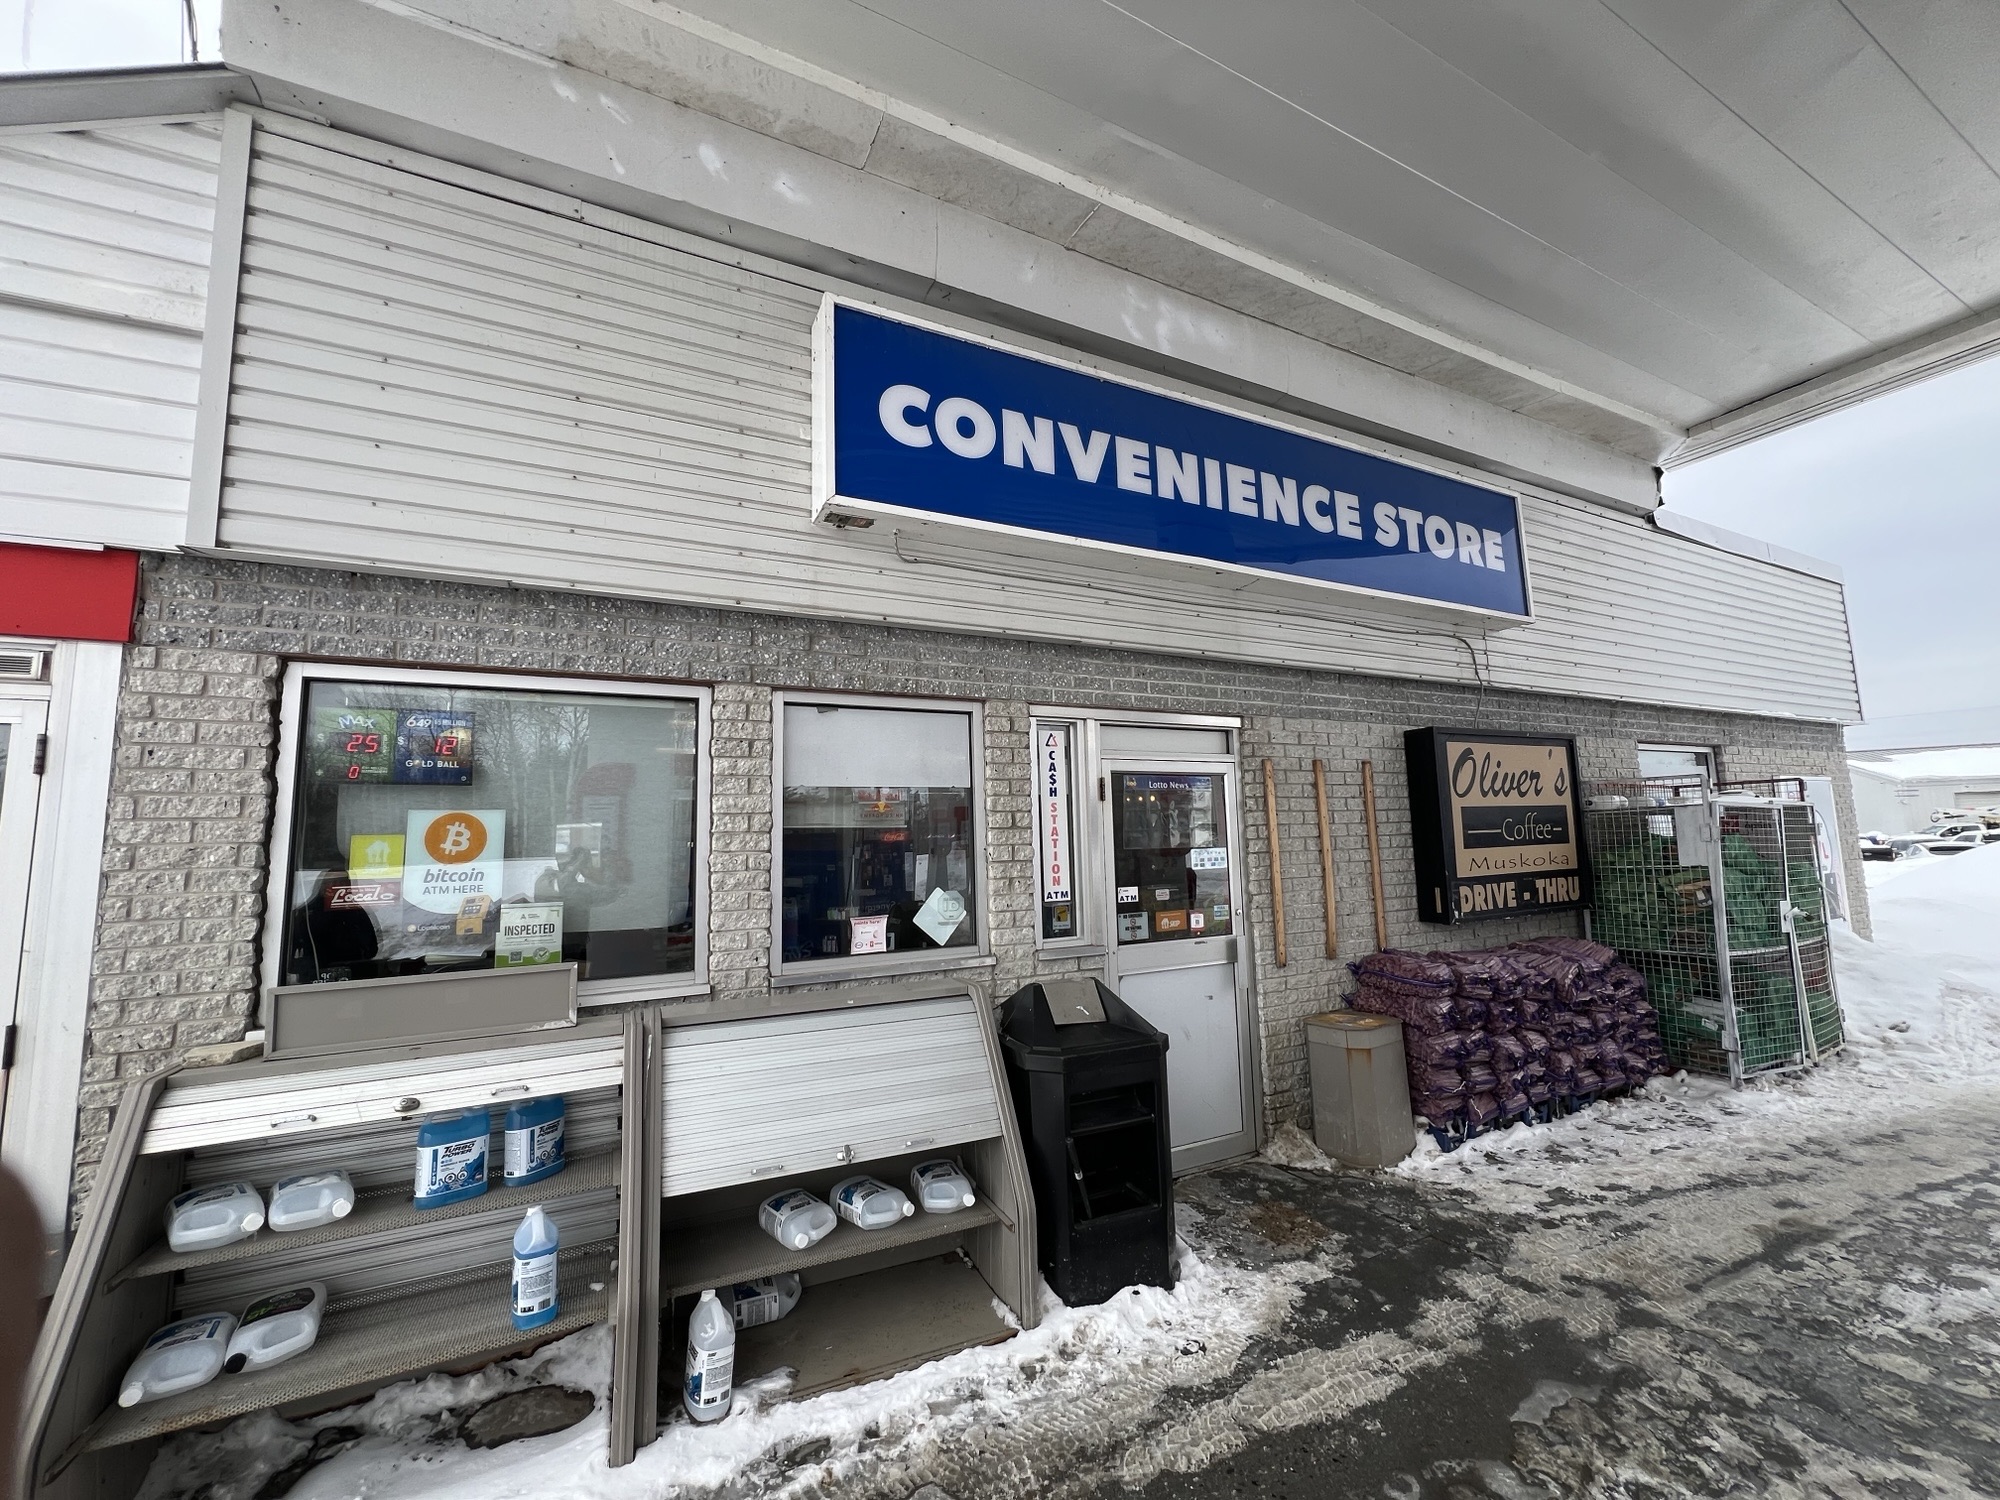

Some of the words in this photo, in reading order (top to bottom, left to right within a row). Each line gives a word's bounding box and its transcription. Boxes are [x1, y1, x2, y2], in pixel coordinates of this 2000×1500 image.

[878, 384, 1363, 541] CONVENIENCE
[1374, 501, 1506, 573] STORE
[338, 714, 374, 729] MAX
[406, 715, 431, 728] 649
[346, 734, 379, 753] 25
[434, 735, 458, 755] 12
[1452, 747, 1568, 798] Oliver's
[1149, 781, 1168, 789] Lotto
[1169, 781, 1189, 789] News
[1503, 812, 1552, 841] Coffee
[1050, 802, 1061, 886] STATION
[1469, 851, 1570, 872] Muskoka
[423, 868, 485, 883] bitcoin
[331, 885, 381, 903] Local
[422, 886, 449, 895] ATM
[452, 884, 484, 894] HERE
[1046, 890, 1069, 900] ATM
[1459, 881, 1517, 914] DRIVE
[1536, 876, 1580, 904] THRU
[1120, 894, 1137, 902] ATM
[504, 923, 556, 937] INSPECTED
[441, 1149, 473, 1160] POWER
[444, 1140, 476, 1155] TURBO
